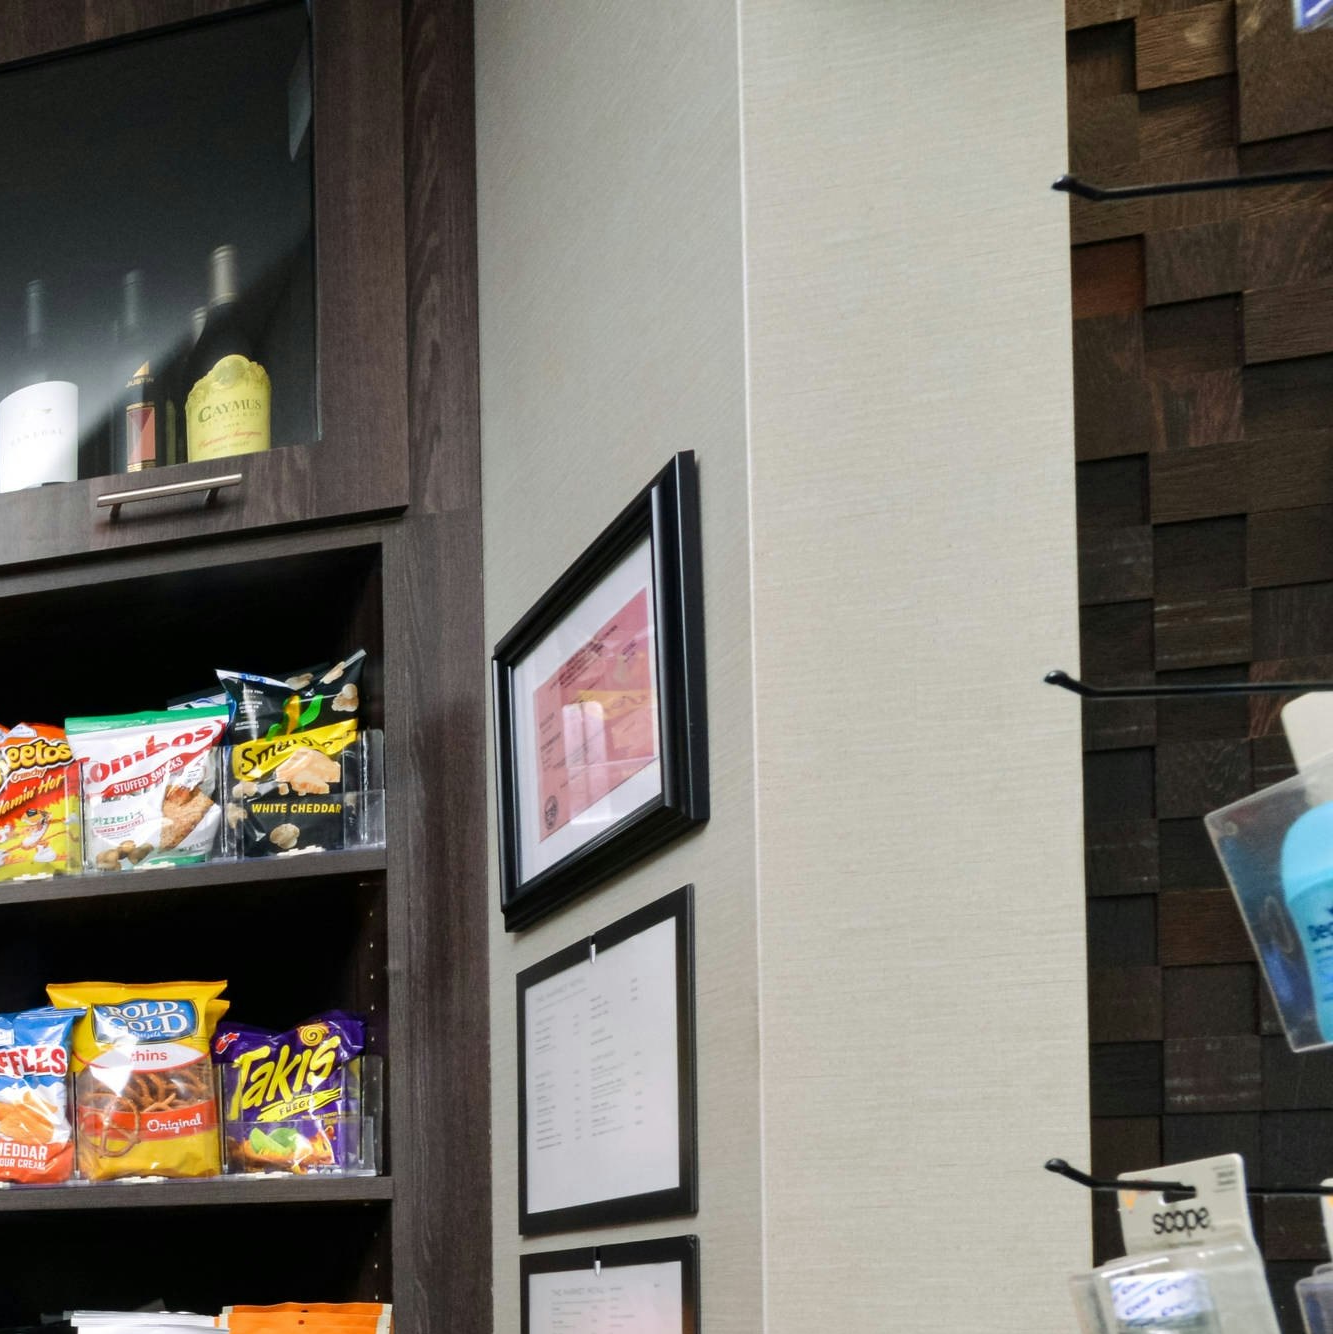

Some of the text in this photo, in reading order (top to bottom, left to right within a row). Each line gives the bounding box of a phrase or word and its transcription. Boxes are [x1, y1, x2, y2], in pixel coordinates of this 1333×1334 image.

[125, 377, 154, 388] JUSTIN
[197, 399, 262, 423] CAYMUS
[10, 768, 47, 783] Crunchy
[37, 773, 65, 793] Hot
[113, 756, 185, 794] STUFFED SNACKS
[251, 803, 342, 814] WHITE CHEDDAR
[230, 1036, 342, 1112] Takis
[278, 1099, 315, 1117] FUEGO
[146, 1113, 203, 1134] Original
